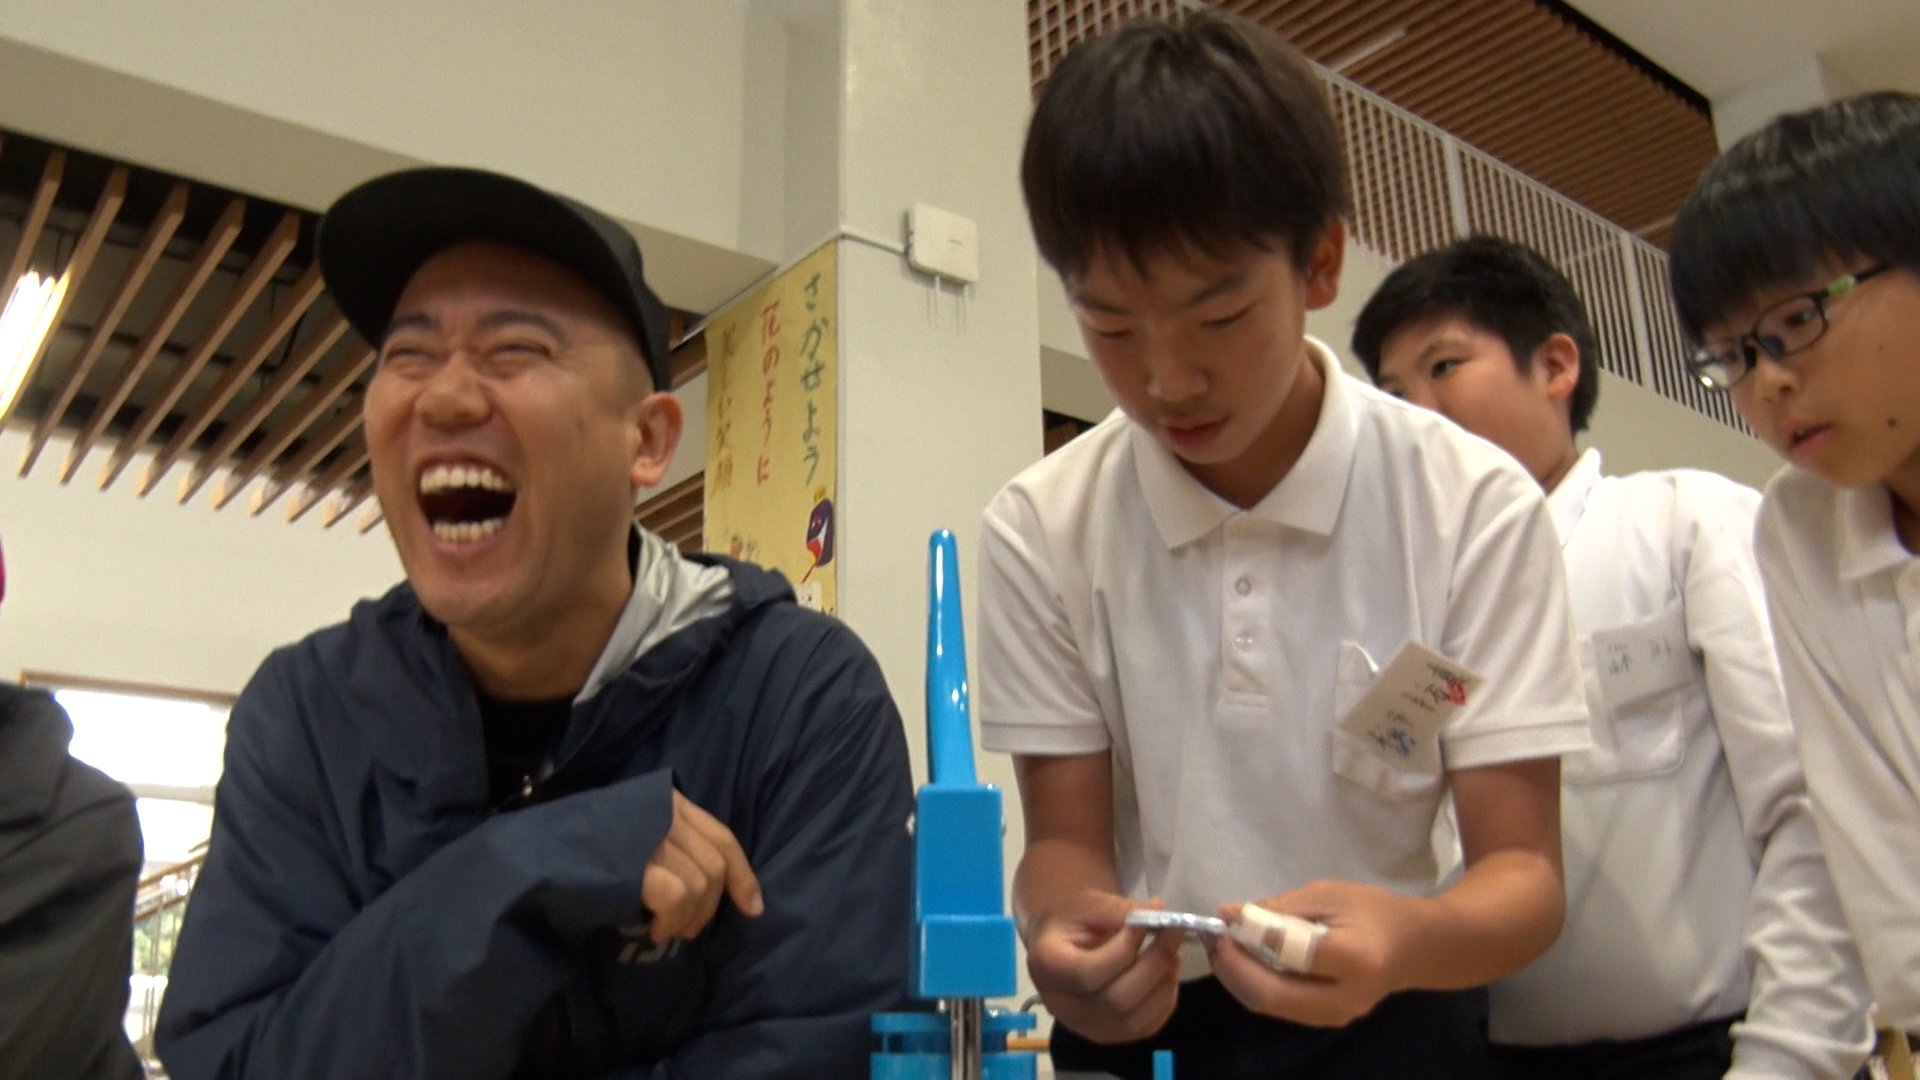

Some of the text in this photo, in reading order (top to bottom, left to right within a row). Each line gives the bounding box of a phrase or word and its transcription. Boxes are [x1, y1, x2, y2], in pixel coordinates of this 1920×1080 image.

[757, 299, 781, 486] 花のように
[800, 272, 829, 488] さかせよう
